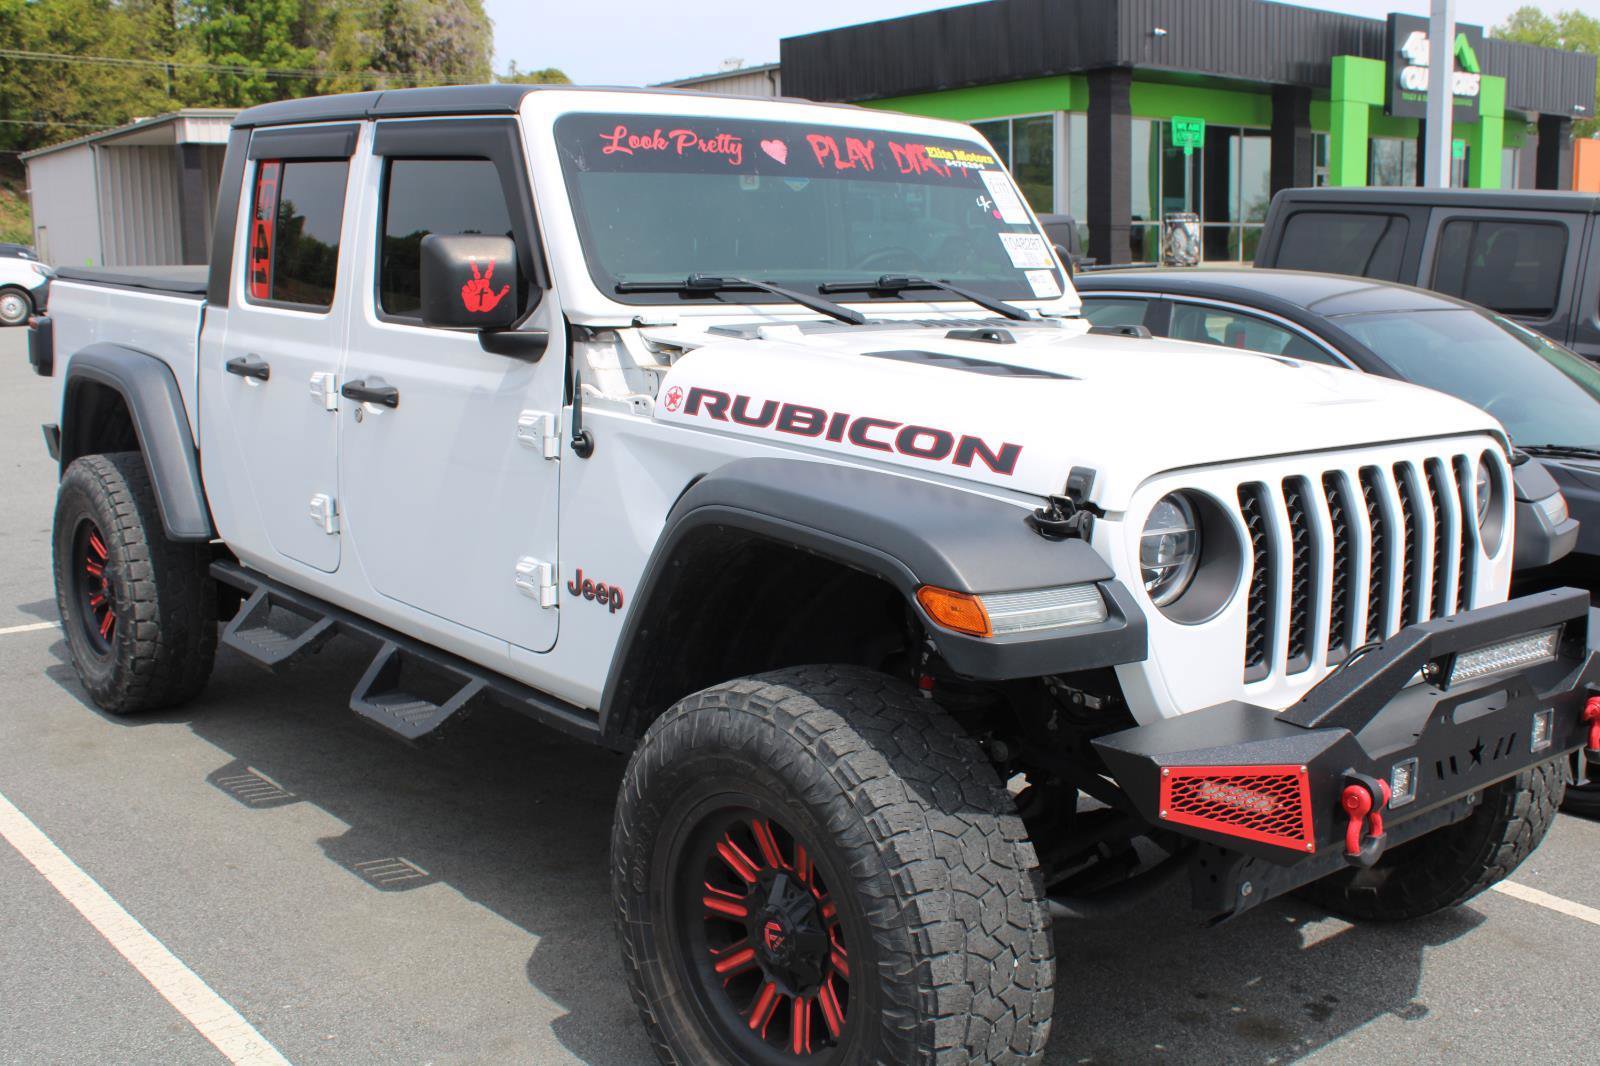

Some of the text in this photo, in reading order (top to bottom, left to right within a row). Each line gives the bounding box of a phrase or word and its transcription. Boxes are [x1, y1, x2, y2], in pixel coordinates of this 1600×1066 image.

[600, 125, 669, 156] Look
[669, 129, 743, 166] Pretty
[806, 134, 876, 172] PLAY
[683, 386, 1024, 476] RUBICON
[567, 568, 624, 614] Jeep
